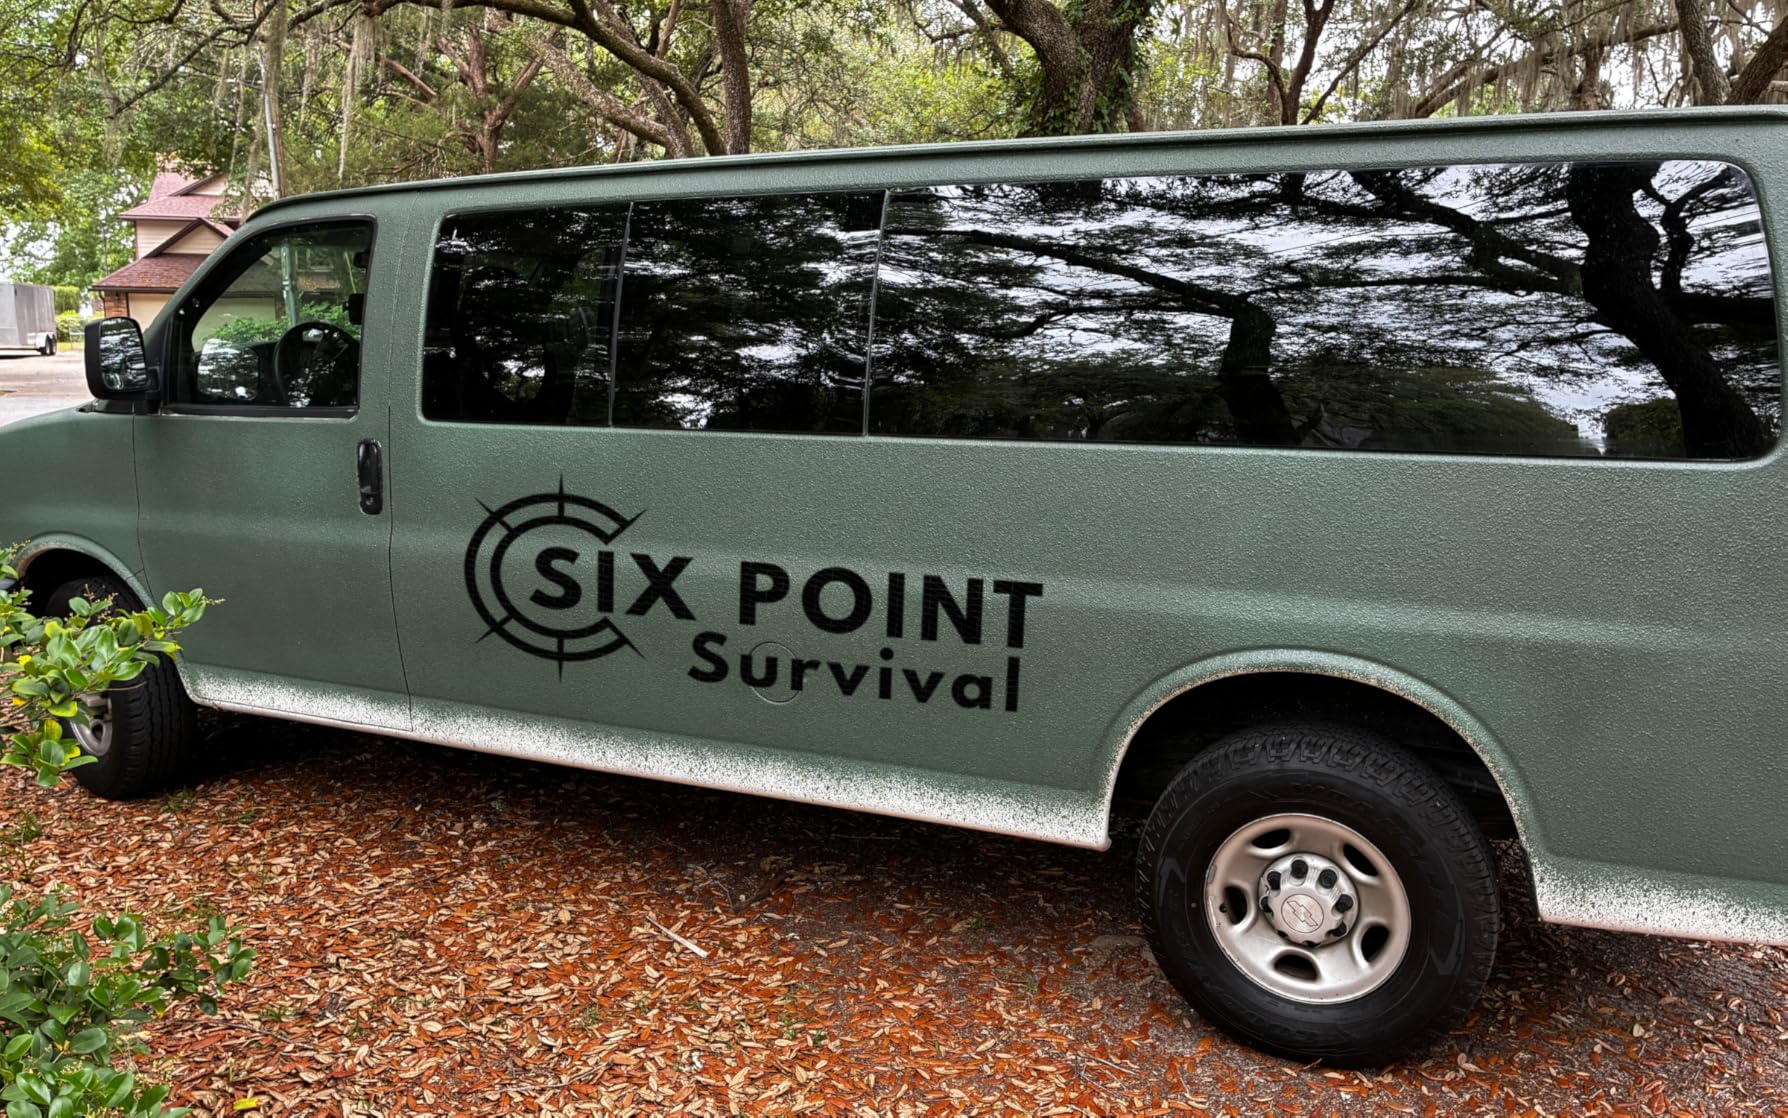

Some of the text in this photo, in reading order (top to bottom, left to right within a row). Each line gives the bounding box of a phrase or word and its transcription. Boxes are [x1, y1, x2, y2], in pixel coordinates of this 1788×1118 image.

[528, 546, 1044, 650] SIX POINT
[686, 630, 1021, 713] Survival
